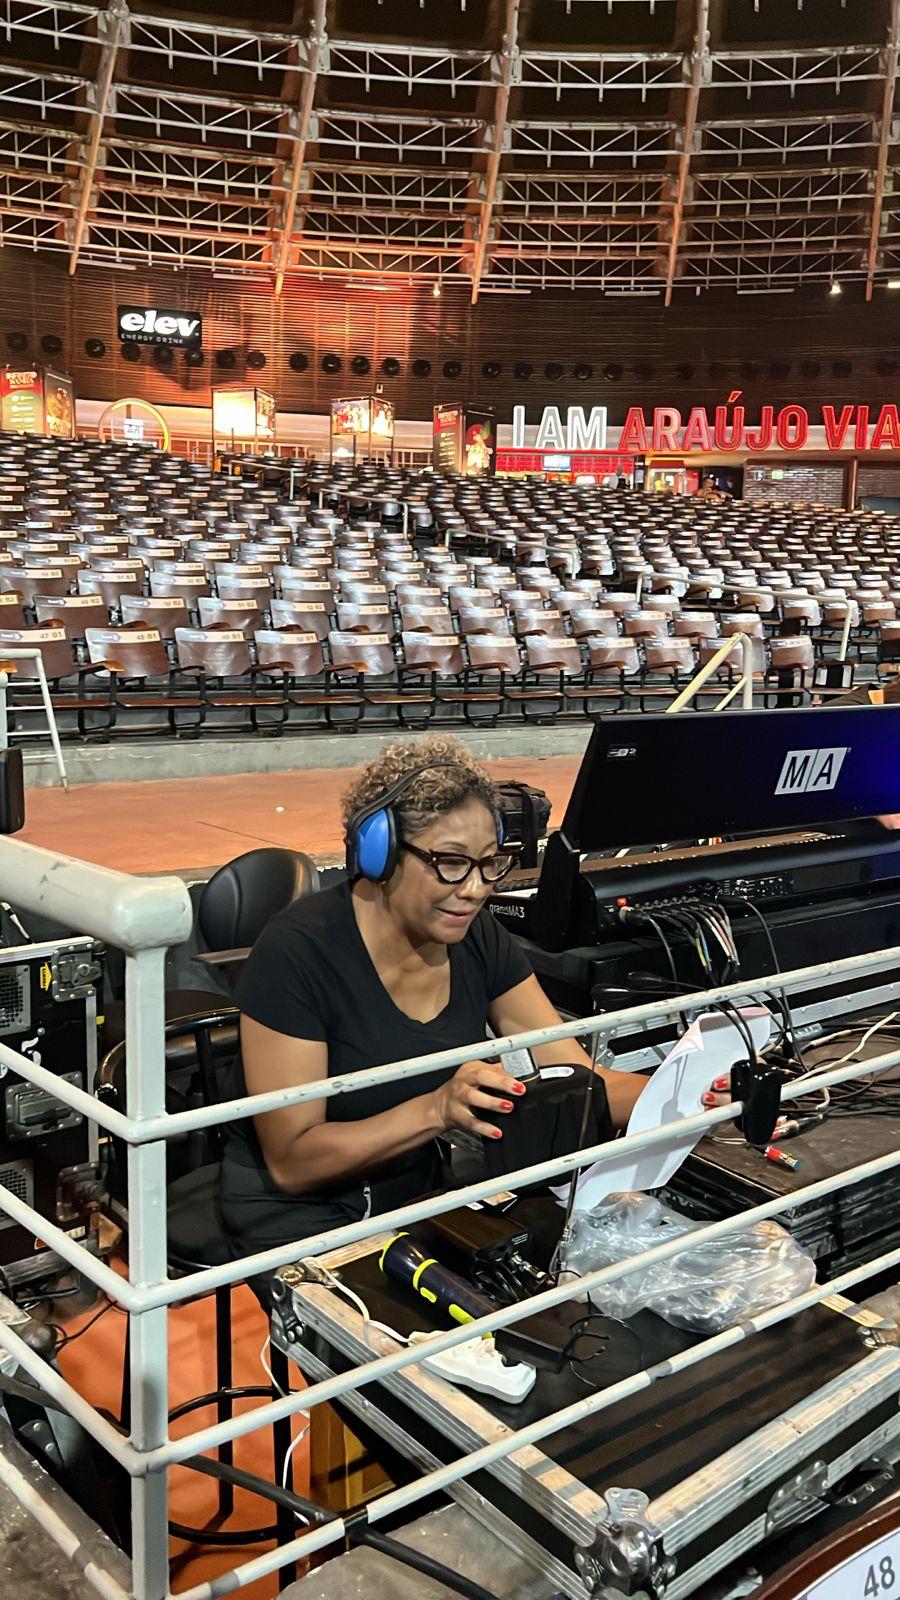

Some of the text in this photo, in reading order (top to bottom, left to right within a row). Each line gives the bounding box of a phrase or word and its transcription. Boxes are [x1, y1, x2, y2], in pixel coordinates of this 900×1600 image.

[120, 310, 200, 337] elev
[121, 333, 153, 342] ENERGY
[512, 405, 525, 449] I
[535, 406, 608, 451] AM
[618, 390, 809, 451] ARAÚJO
[780, 751, 837, 790] MA
[864, 1555, 896, 1598] 48
